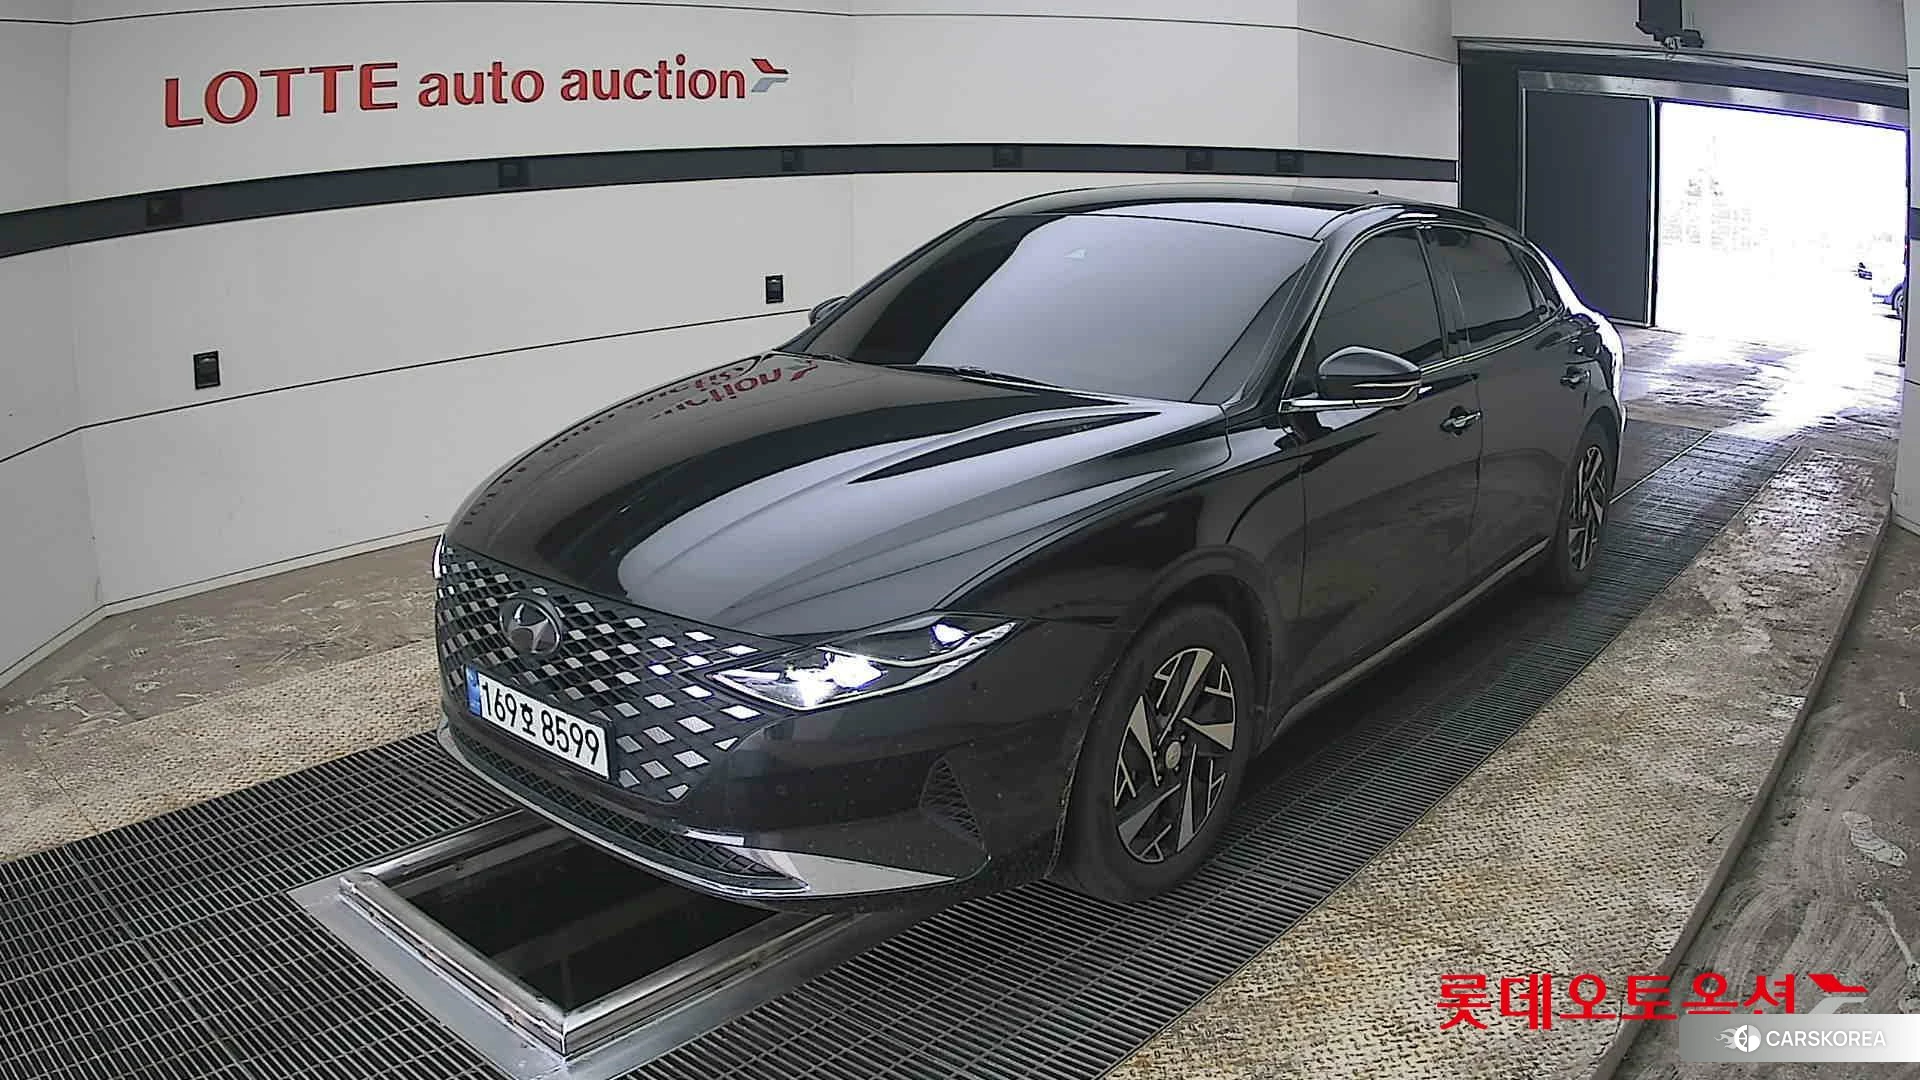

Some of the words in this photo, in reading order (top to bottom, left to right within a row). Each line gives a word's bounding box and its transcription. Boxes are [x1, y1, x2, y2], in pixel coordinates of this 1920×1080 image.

[164, 62, 398, 128] LOTTE
[418, 61, 545, 107] auto
[560, 54, 746, 101] auction
[541, 709, 600, 765] 8599
